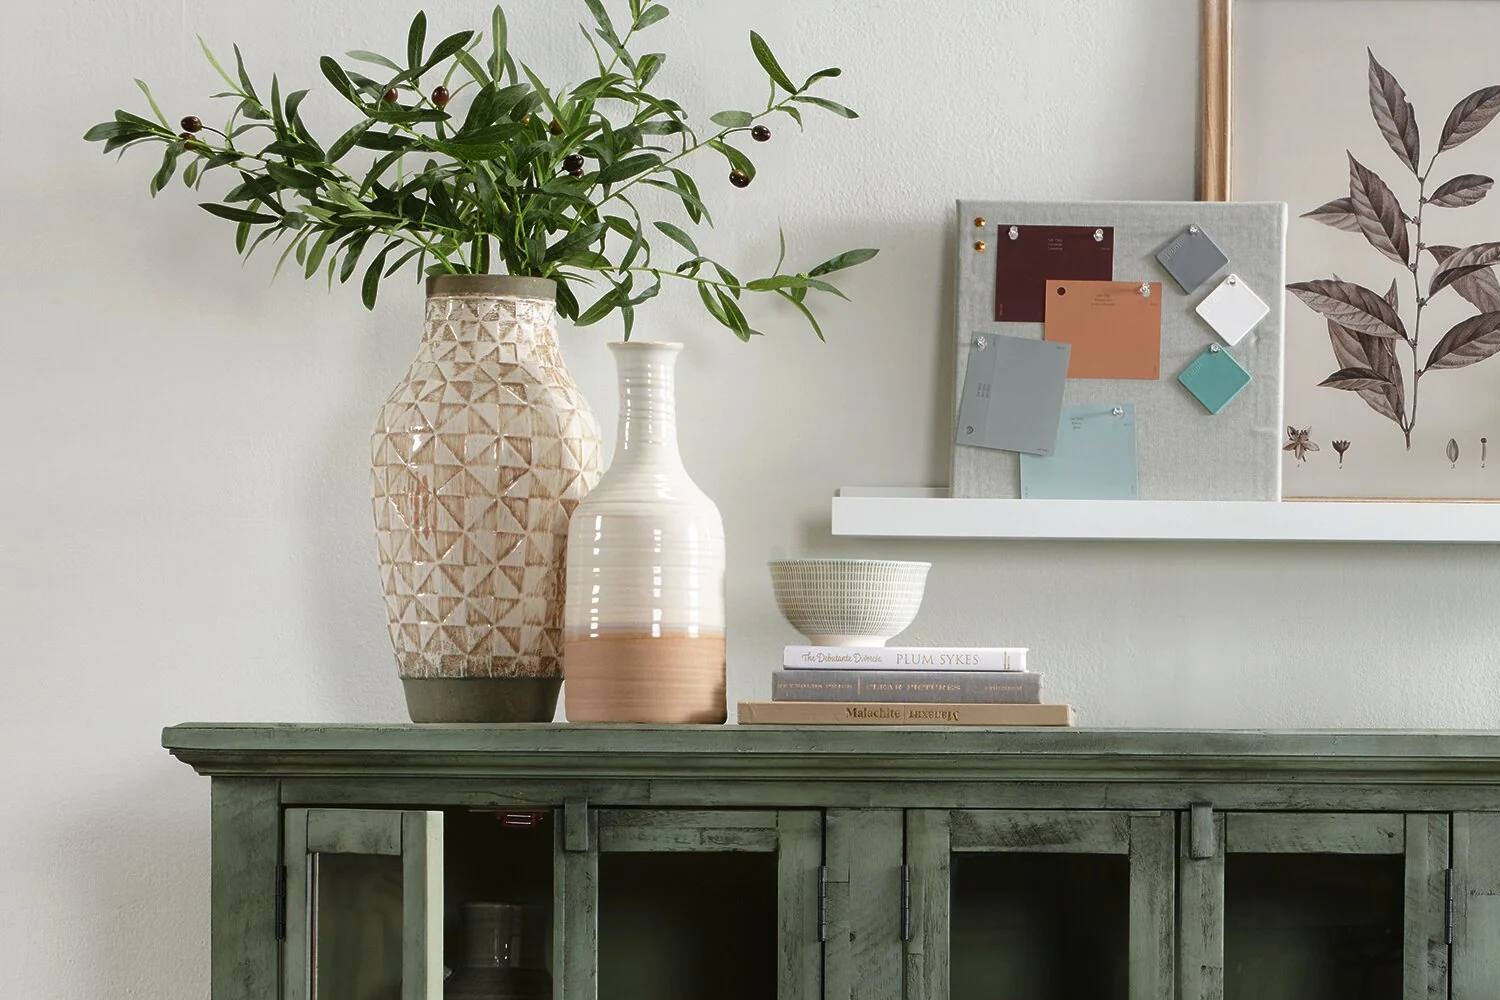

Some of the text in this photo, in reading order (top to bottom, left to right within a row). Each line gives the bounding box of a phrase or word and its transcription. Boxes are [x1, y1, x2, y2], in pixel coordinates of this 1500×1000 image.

[801, 652, 816, 663] The
[896, 654, 979, 665] PLUM SYKES
[846, 707, 901, 719] Malachite
